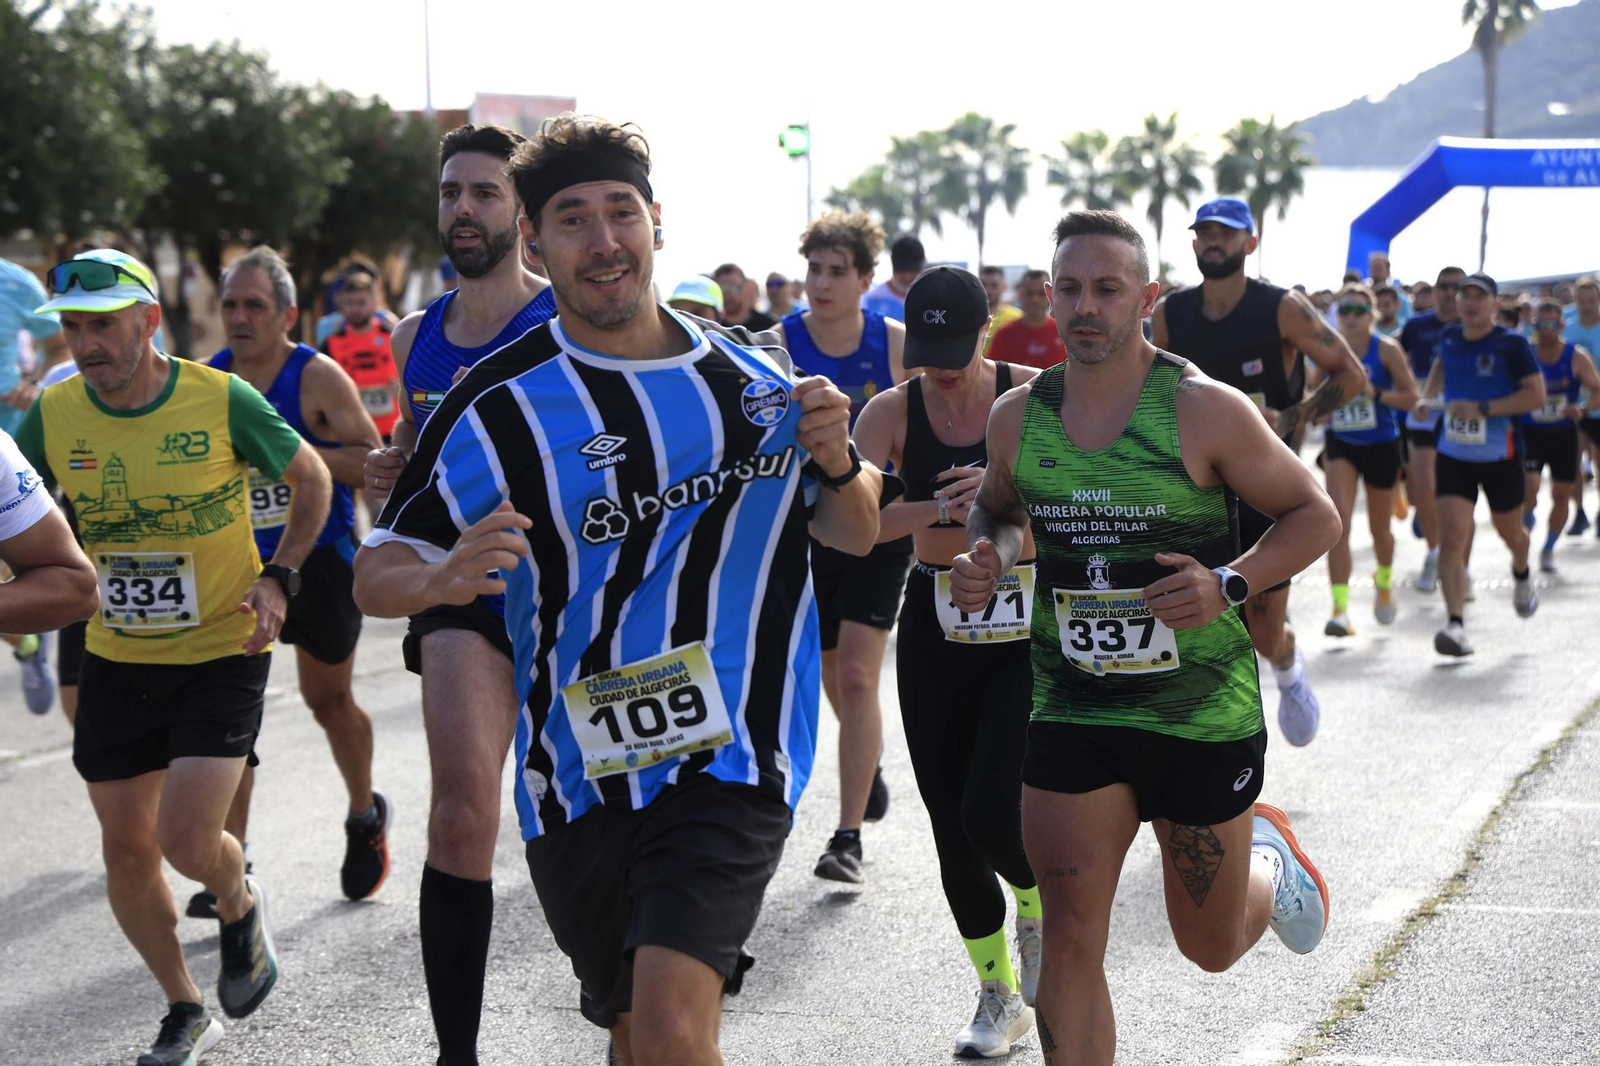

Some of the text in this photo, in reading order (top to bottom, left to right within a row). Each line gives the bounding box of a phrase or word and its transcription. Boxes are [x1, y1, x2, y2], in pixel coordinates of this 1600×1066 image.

[1530, 148, 1600, 168] AYUN
[923, 309, 947, 325] CK
[588, 452, 627, 470] umbro
[250, 484, 291, 510] 98
[1072, 488, 1111, 502] XXVII
[1028, 503, 1167, 518] CARRERA POPULAR
[1045, 521, 1149, 533] VIRGEN DEL PILAR
[1071, 535, 1121, 545] ALGECIRAS
[108, 576, 186, 607] 334
[996, 583, 1021, 591] GECIRAS
[1069, 600, 1108, 610] CARRERA
[1071, 607, 1151, 619] CIUDAD DE ALGECIRAS
[1067, 616, 1156, 653] 337
[585, 661, 687, 695] CARRERA URBANA
[589, 672, 692, 706] CIUDAD DE ALGECIRAS
[588, 684, 708, 744] 109
